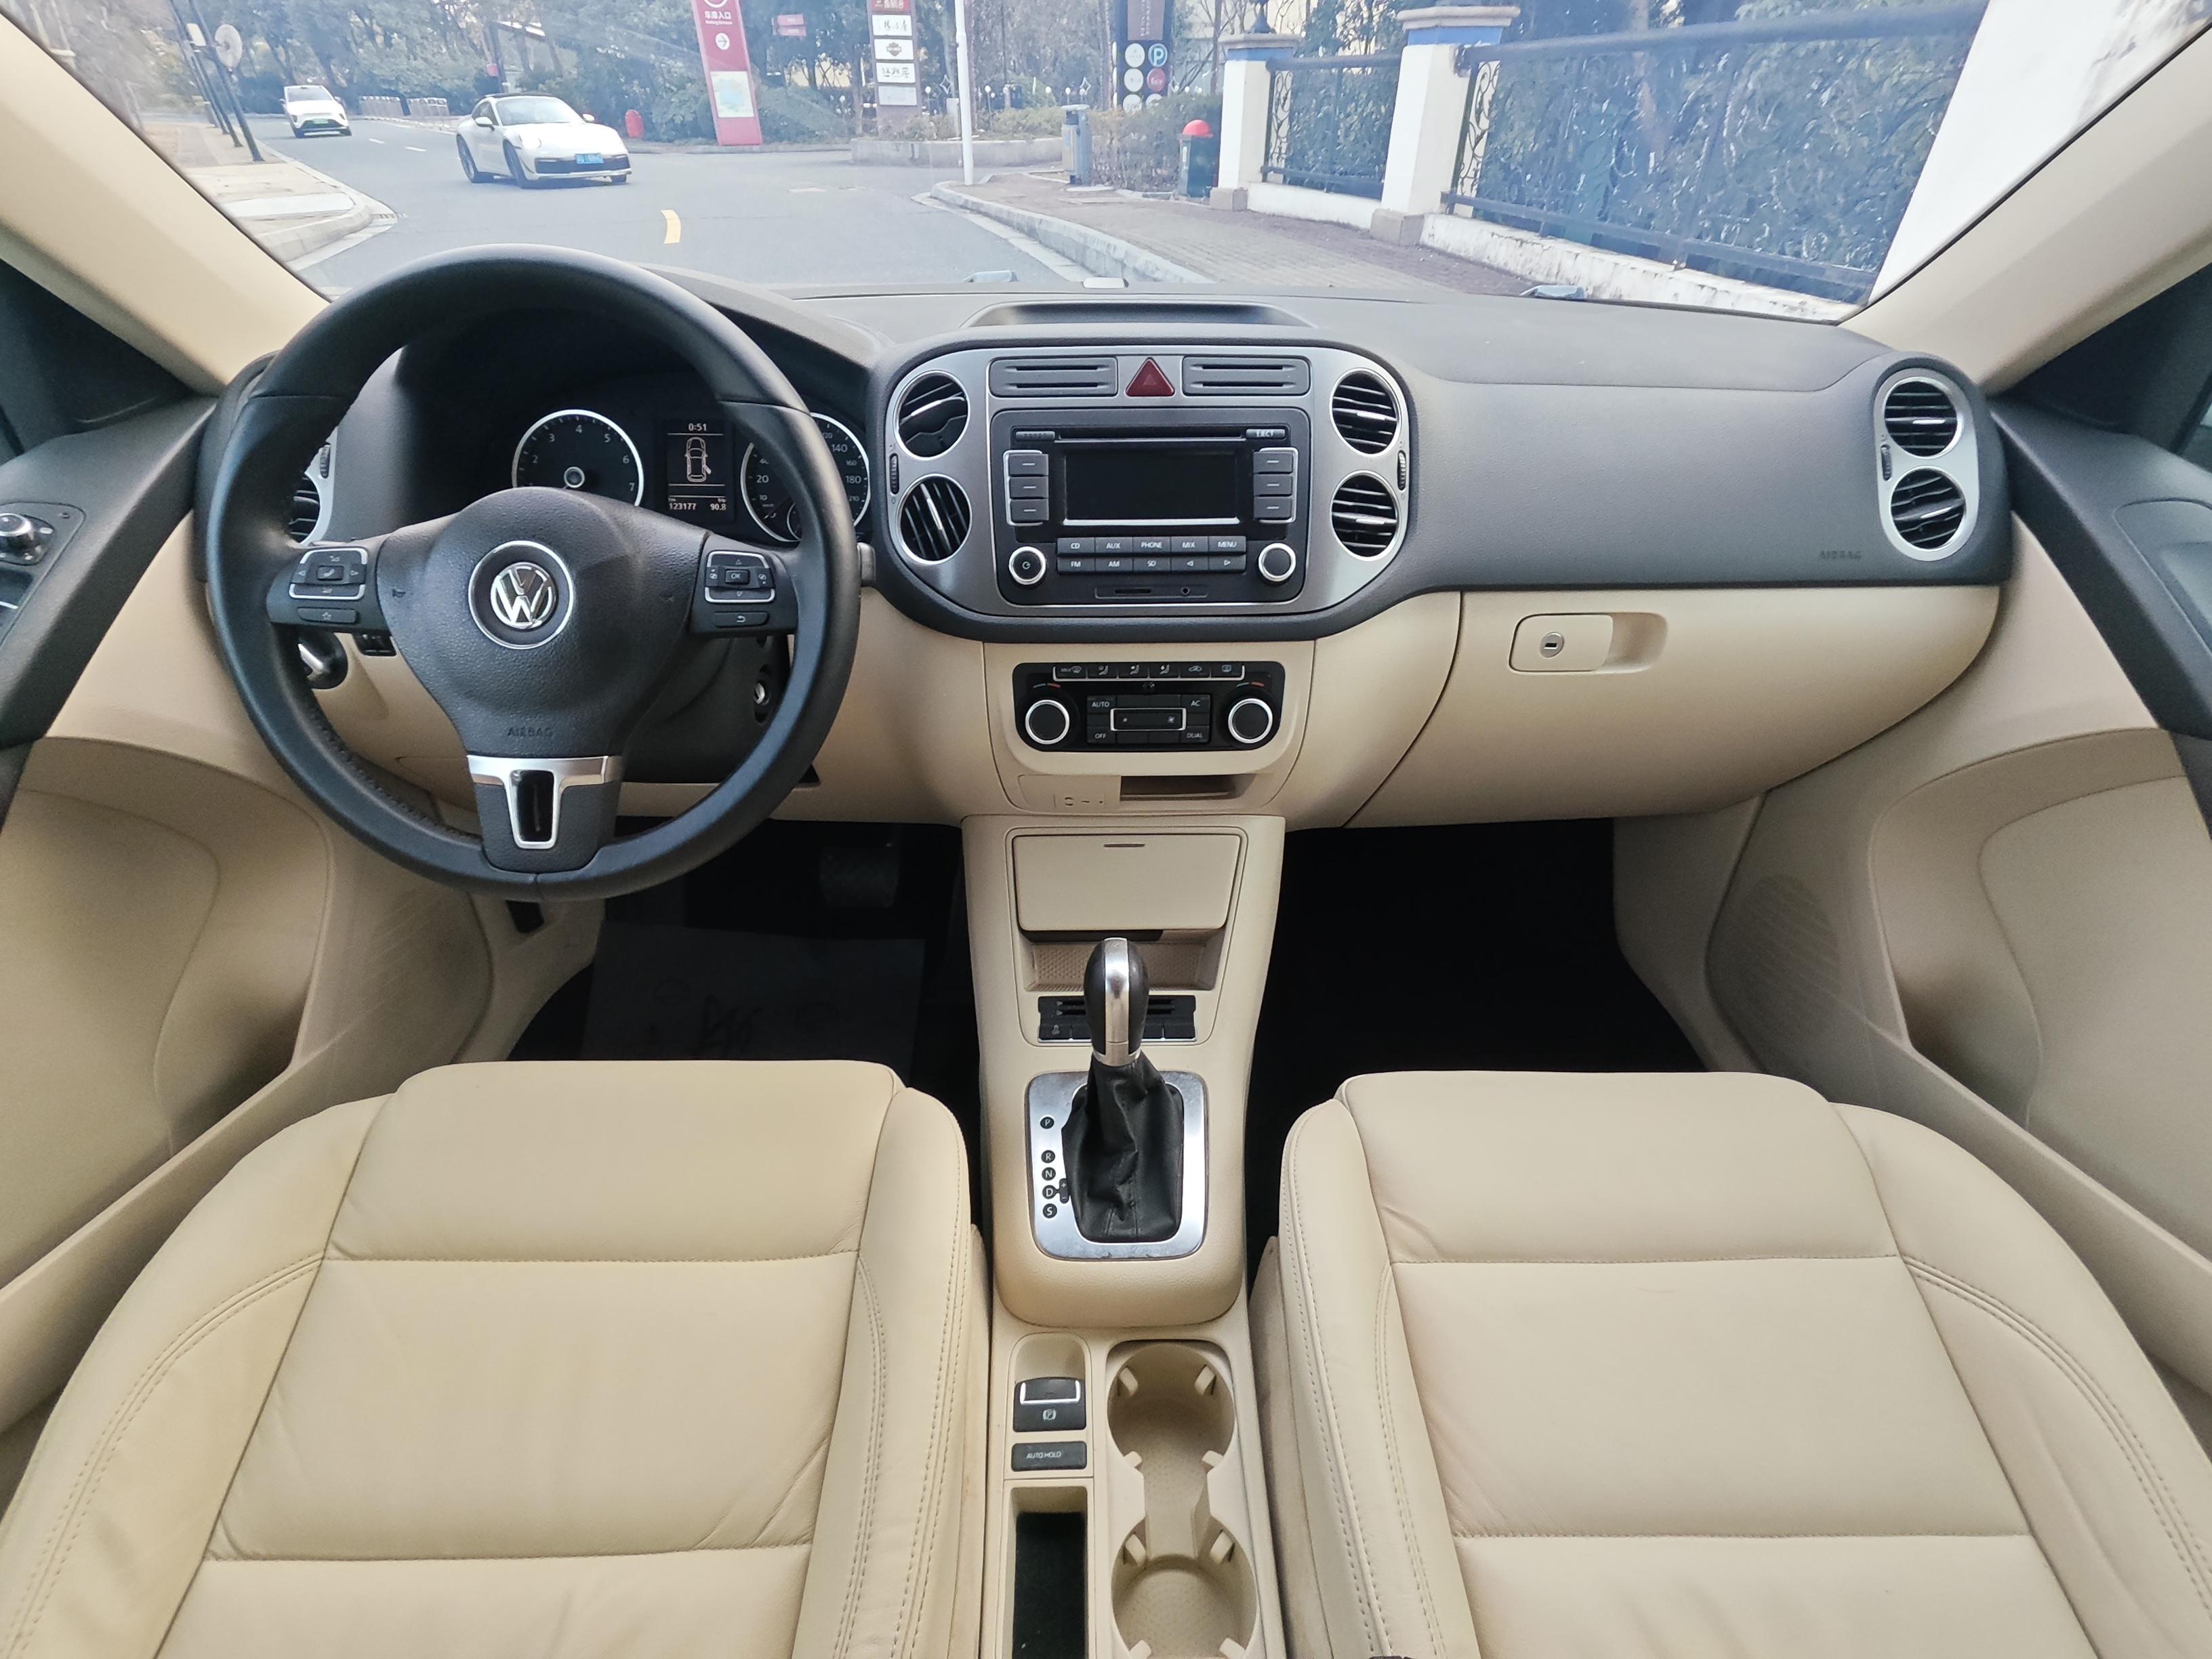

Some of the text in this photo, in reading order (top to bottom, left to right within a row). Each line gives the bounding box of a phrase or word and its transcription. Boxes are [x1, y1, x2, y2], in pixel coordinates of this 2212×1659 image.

[576, 424, 582, 433] 4
[688, 423, 707, 431] 0:51
[550, 433, 555, 442] 3
[605, 434, 610, 442] 5
[832, 444, 847, 453] 140
[532, 455, 538, 464] 2
[623, 455, 630, 464] 6
[756, 475, 769, 483] 20
[845, 476, 861, 484] 180
[630, 483, 635, 491] 7
[1046, 1153, 1051, 1161] R
[1045, 1170, 1052, 1178] N
[1046, 1188, 1053, 1197] D
[1046, 1207, 1052, 1216] S
